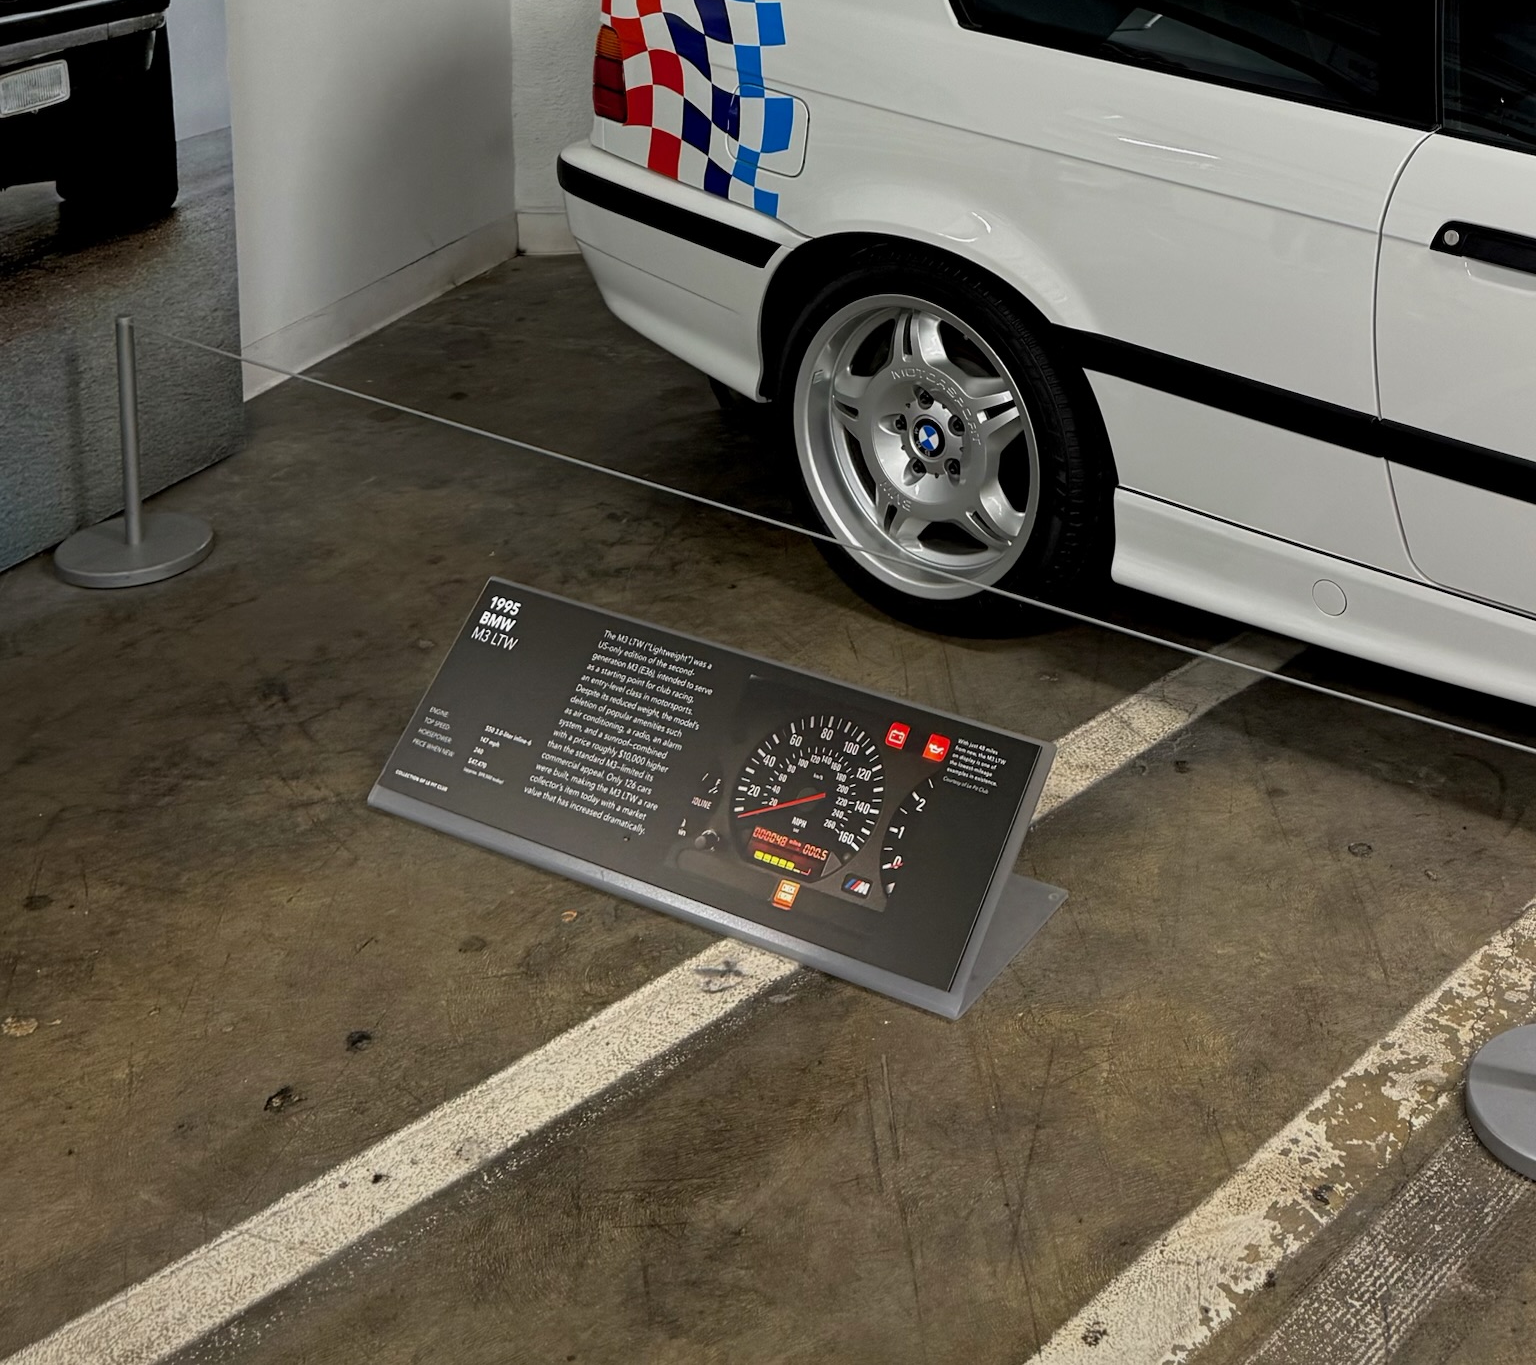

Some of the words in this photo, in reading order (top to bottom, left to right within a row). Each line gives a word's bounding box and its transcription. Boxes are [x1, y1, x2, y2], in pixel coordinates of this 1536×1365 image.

[490, 596, 521, 616] 1995
[479, 611, 516, 632] BMW
[471, 626, 491, 642] M3
[490, 632, 518, 650] LTW
[604, 629, 616, 640] The
[616, 634, 629, 644] M3
[628, 638, 645, 648] LTW
[693, 659, 707, 668] was
[598, 640, 624, 656] US-only
[624, 650, 647, 662] edition
[656, 659, 668, 668] the
[591, 653, 626, 668] generation
[627, 662, 639, 672] M3
[656, 671, 687, 687] intended
[686, 681, 694, 689] to
[694, 685, 713, 695] serve
[590, 678, 626, 693] entry-level
[625, 688, 642, 699] class
[642, 692, 650, 701] in
[650, 697, 693, 715] motorsports.
[600, 668, 626, 683] starting
[625, 676, 645, 687] point
[645, 680, 656, 690] for
[656, 684, 671, 695] club
[671, 690, 694, 704] racing,
[575, 683, 600, 698] Despite
[600, 693, 609, 701] its
[609, 696, 638, 710] reduced
[661, 712, 673, 721] the
[558, 718, 582, 732] system,
[584, 727, 599, 736] and
[570, 695, 597, 710] deletion
[598, 704, 607, 712] of
[605, 708, 633, 721] popular
[632, 717, 665, 732] amenities
[665, 728, 682, 738] such
[564, 707, 573, 715] as
[582, 714, 624, 734] conditioning,
[632, 730, 650, 742] radio,
[652, 736, 662, 744] an
[662, 739, 682, 751] alarm
[820, 727, 834, 740] 80
[553, 730, 568, 739] with
[572, 737, 591, 747] price
[591, 743, 618, 758] roughly
[618, 749, 646, 765] $10,000
[645, 758, 669, 773] higher
[789, 734, 803, 747] 60
[843, 741, 859, 755] 100
[547, 740, 563, 751] than
[563, 745, 575, 755] the
[575, 750, 606, 765] standard
[644, 772, 654, 782] its
[763, 754, 776, 767] 40
[541, 752, 581, 770] commercial
[606, 772, 623, 786] Only
[624, 778, 637, 789] 126
[637, 785, 652, 795] cars
[856, 767, 873, 781] 120
[536, 764, 552, 774] were
[570, 776, 596, 791] making
[596, 783, 608, 793] the
[609, 787, 622, 797] M3
[621, 791, 639, 803] LTW
[643, 801, 658, 811] rare
[747, 784, 761, 797] 20
[524, 786, 542, 797] value
[542, 791, 557, 803] that
[556, 795, 569, 807] has
[569, 801, 604, 819] increased
[603, 813, 645, 835] dramatically.
[564, 785, 580, 797] item
[580, 792, 600, 806] today
[600, 800, 615, 809] with
[621, 807, 647, 821] market
[831, 808, 844, 819] 240
[854, 800, 870, 814] 140
[916, 798, 926, 812] 2
[791, 816, 807, 828] MPH
[898, 826, 905, 839] 1
[838, 831, 854, 846] 160
